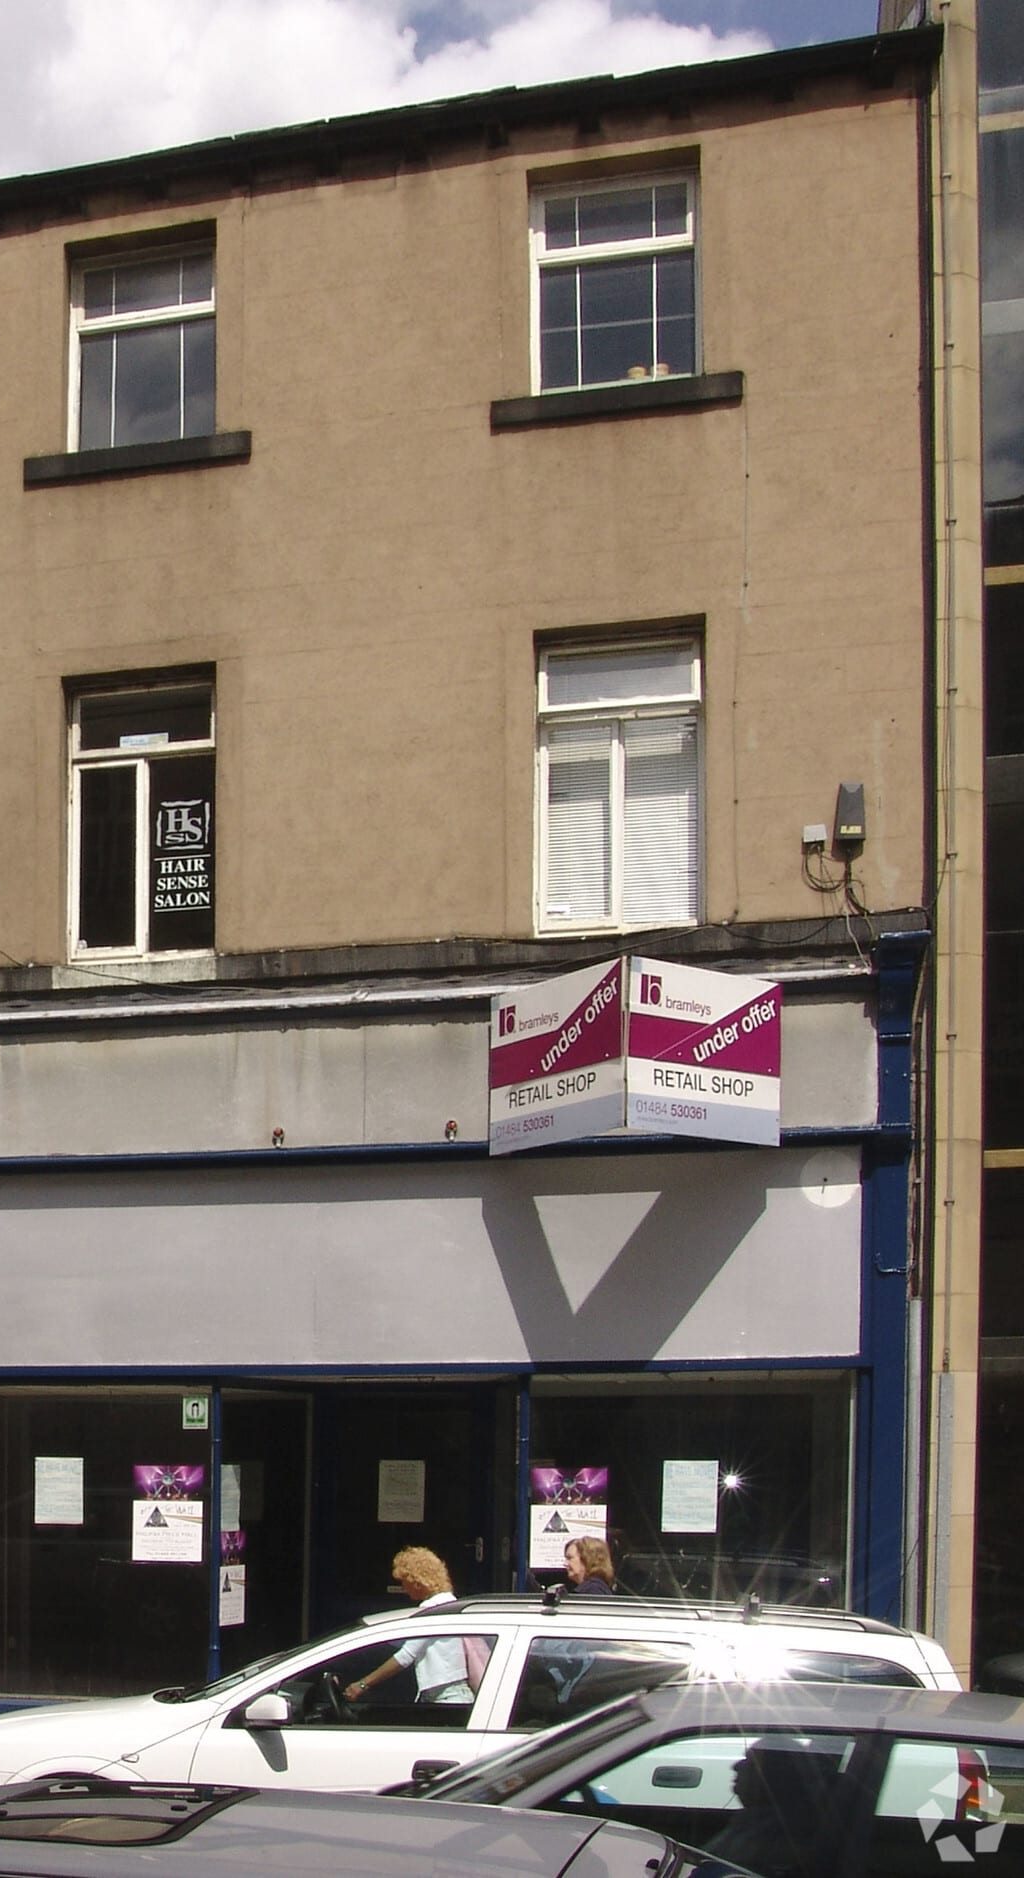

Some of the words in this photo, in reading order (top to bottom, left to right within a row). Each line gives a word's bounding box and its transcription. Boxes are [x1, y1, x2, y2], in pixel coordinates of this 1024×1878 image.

[160, 858, 205, 874] HAIR
[156, 874, 209, 891] SENSE
[154, 891, 211, 908] SALON
[665, 995, 712, 1017] bramleys
[518, 1011, 559, 1032] bramleys
[540, 1018, 582, 1072] under
[584, 977, 618, 1024] offer
[692, 1022, 739, 1063] under
[741, 999, 776, 1033] offer
[509, 1088, 552, 1109] RETAIL
[557, 1071, 597, 1097] SHOP
[653, 1068, 707, 1092] RETAIL
[711, 1076, 754, 1097] SHOP
[636, 1100, 668, 1115] 01484
[670, 1103, 708, 1120] 530361
[495, 1124, 521, 1139] 01484
[523, 1115, 555, 1134] 530361
